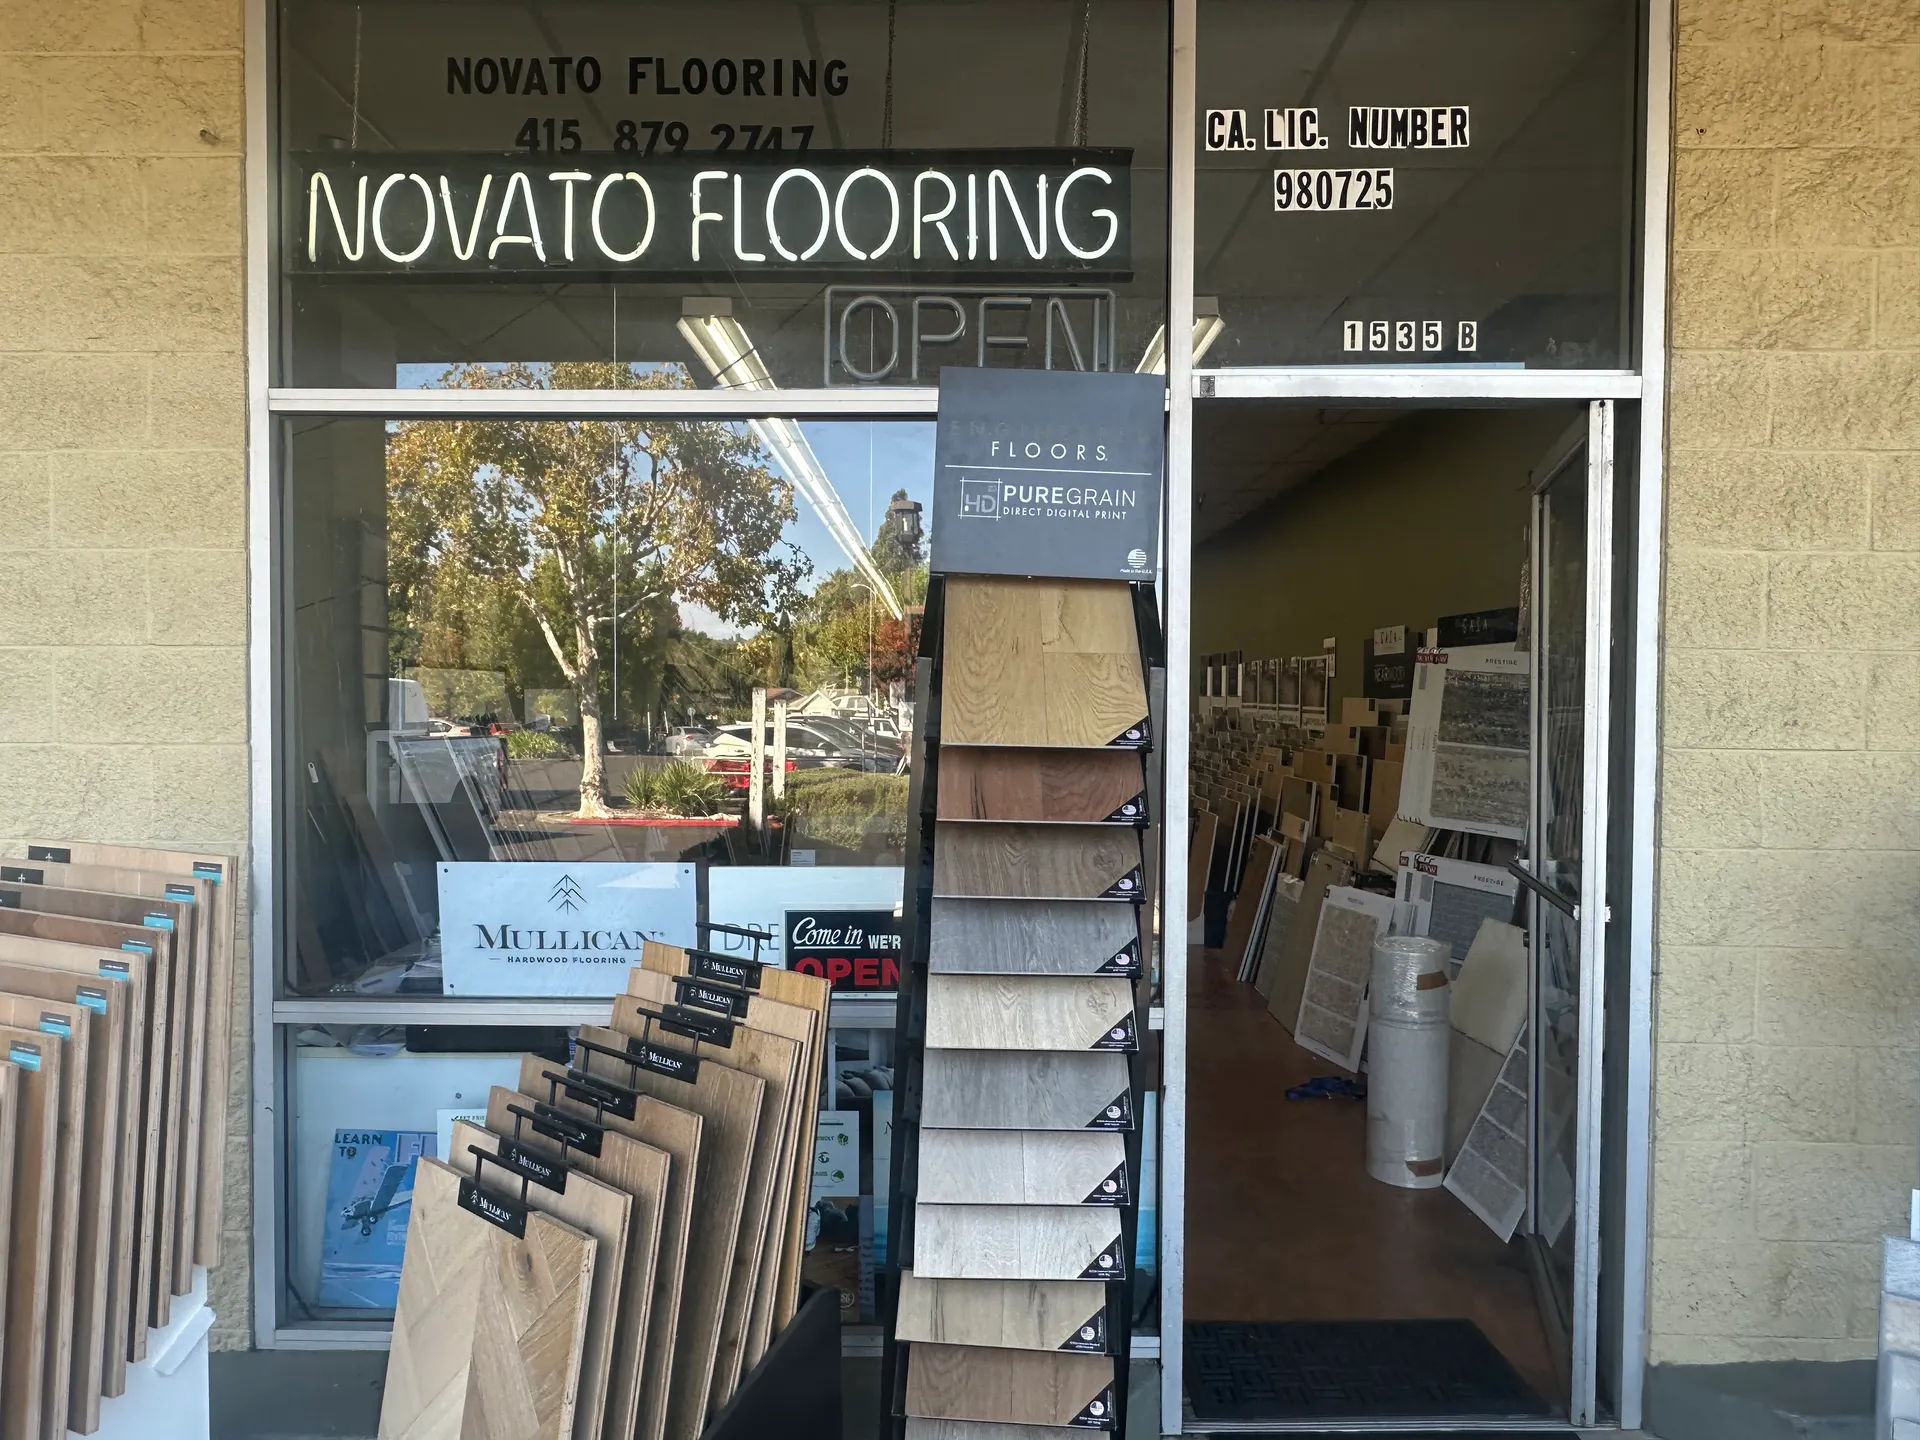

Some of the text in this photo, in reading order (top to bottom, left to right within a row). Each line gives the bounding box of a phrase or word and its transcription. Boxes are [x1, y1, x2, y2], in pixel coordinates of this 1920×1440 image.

[447, 57, 849, 97] NOVATO FLOORING
[515, 118, 815, 156] 415 879 2747
[1208, 107, 1469, 150] CA. LIC. NUMBER
[1276, 169, 1393, 209] 980725
[308, 167, 1118, 263] NOVATO FLOORING
[839, 296, 1101, 381] OPEN
[1347, 322, 1475, 350] 1535 B
[991, 441, 1107, 460] FLOORS
[1003, 485, 1136, 507] PUREGRAIN
[1003, 506, 1127, 520] DIRECT DIGITAL PRINT
[792, 917, 841, 945] Come
[845, 925, 863, 945] in
[507, 955, 626, 964] HARDWOOD FLOORING
[335, 1133, 383, 1145] LEARN
